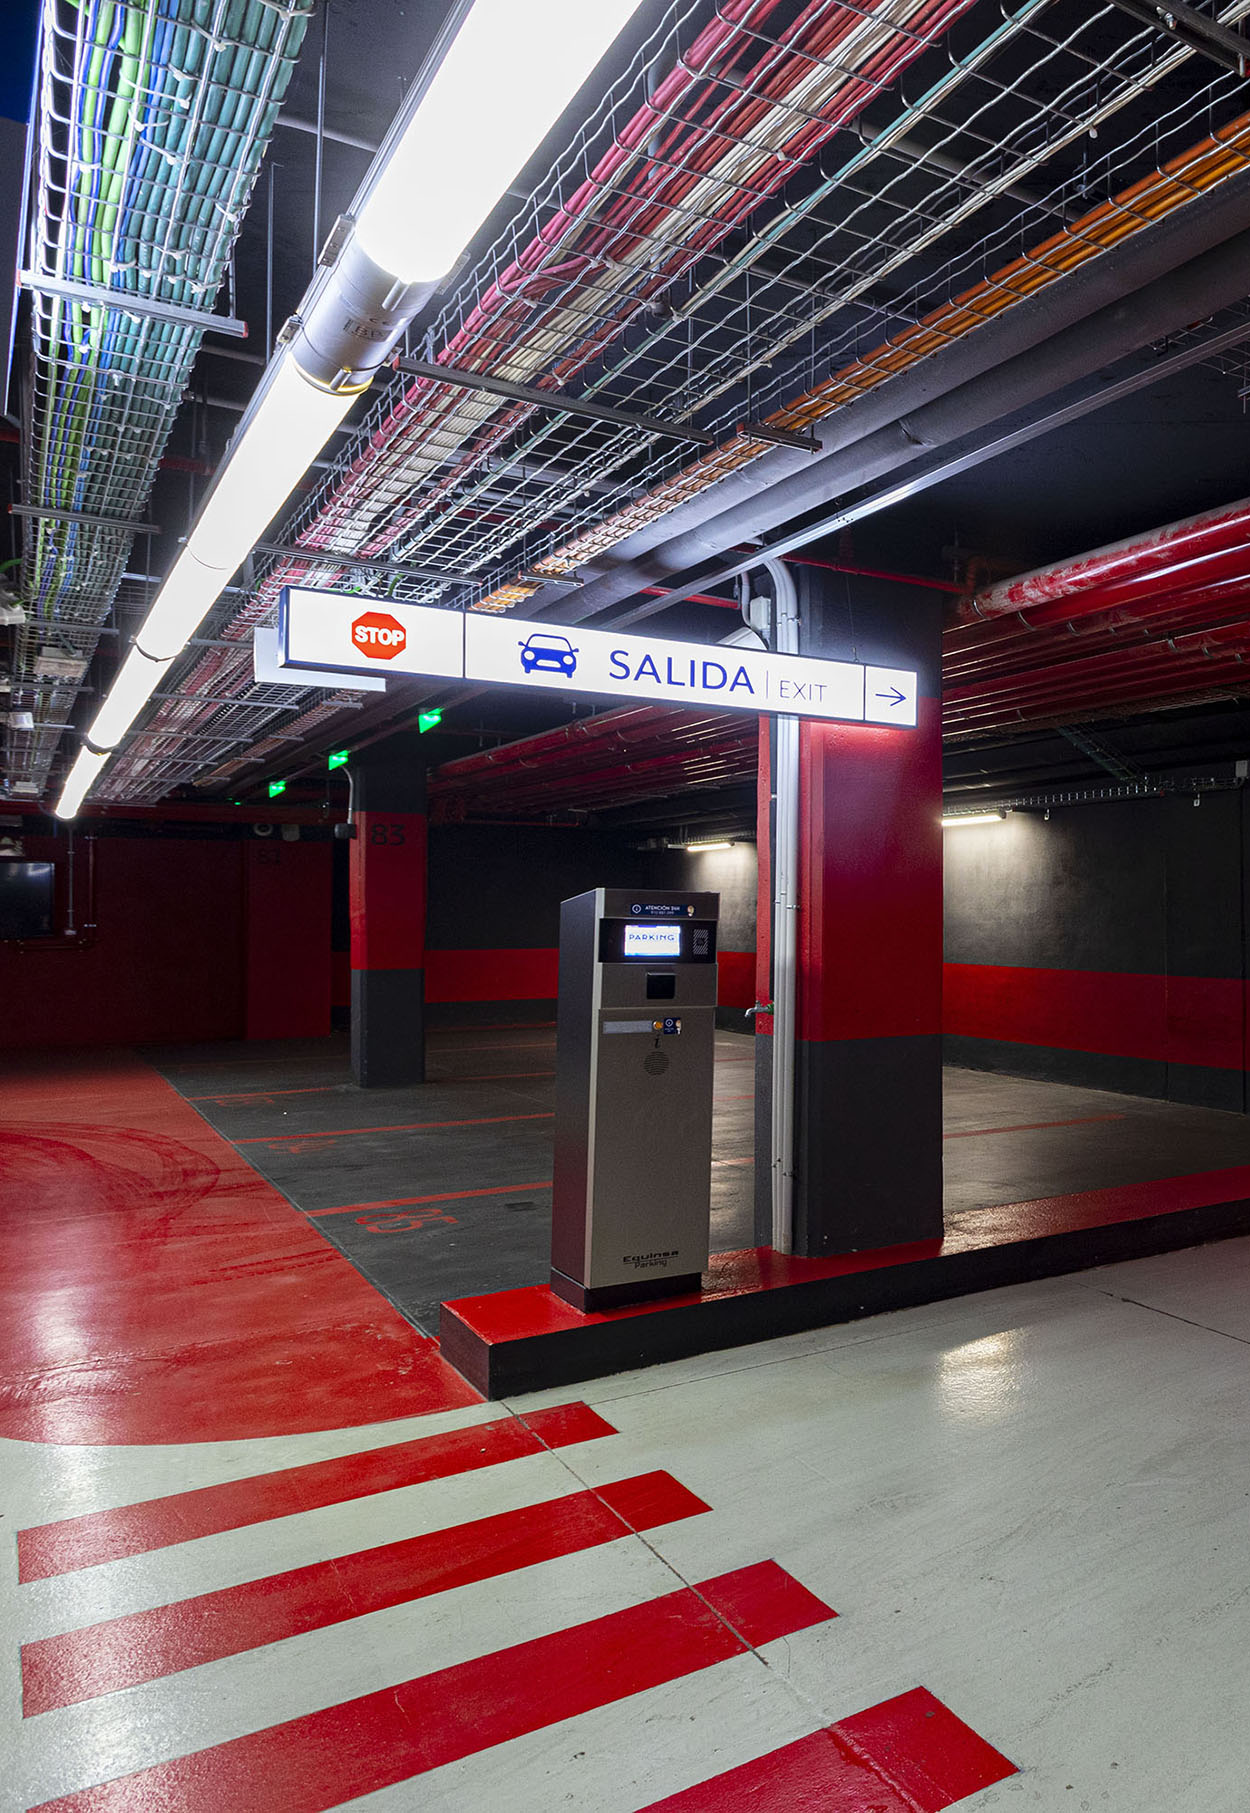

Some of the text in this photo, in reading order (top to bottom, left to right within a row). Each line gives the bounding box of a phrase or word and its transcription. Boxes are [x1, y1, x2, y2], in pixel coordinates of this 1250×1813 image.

[355, 625, 405, 646] STOP
[609, 650, 828, 702] SALIDA EXIT
[371, 824, 405, 846] 83
[628, 934, 675, 942] PARKING
[623, 1251, 678, 1263] Equinsa
[634, 1260, 668, 1269] Parking
